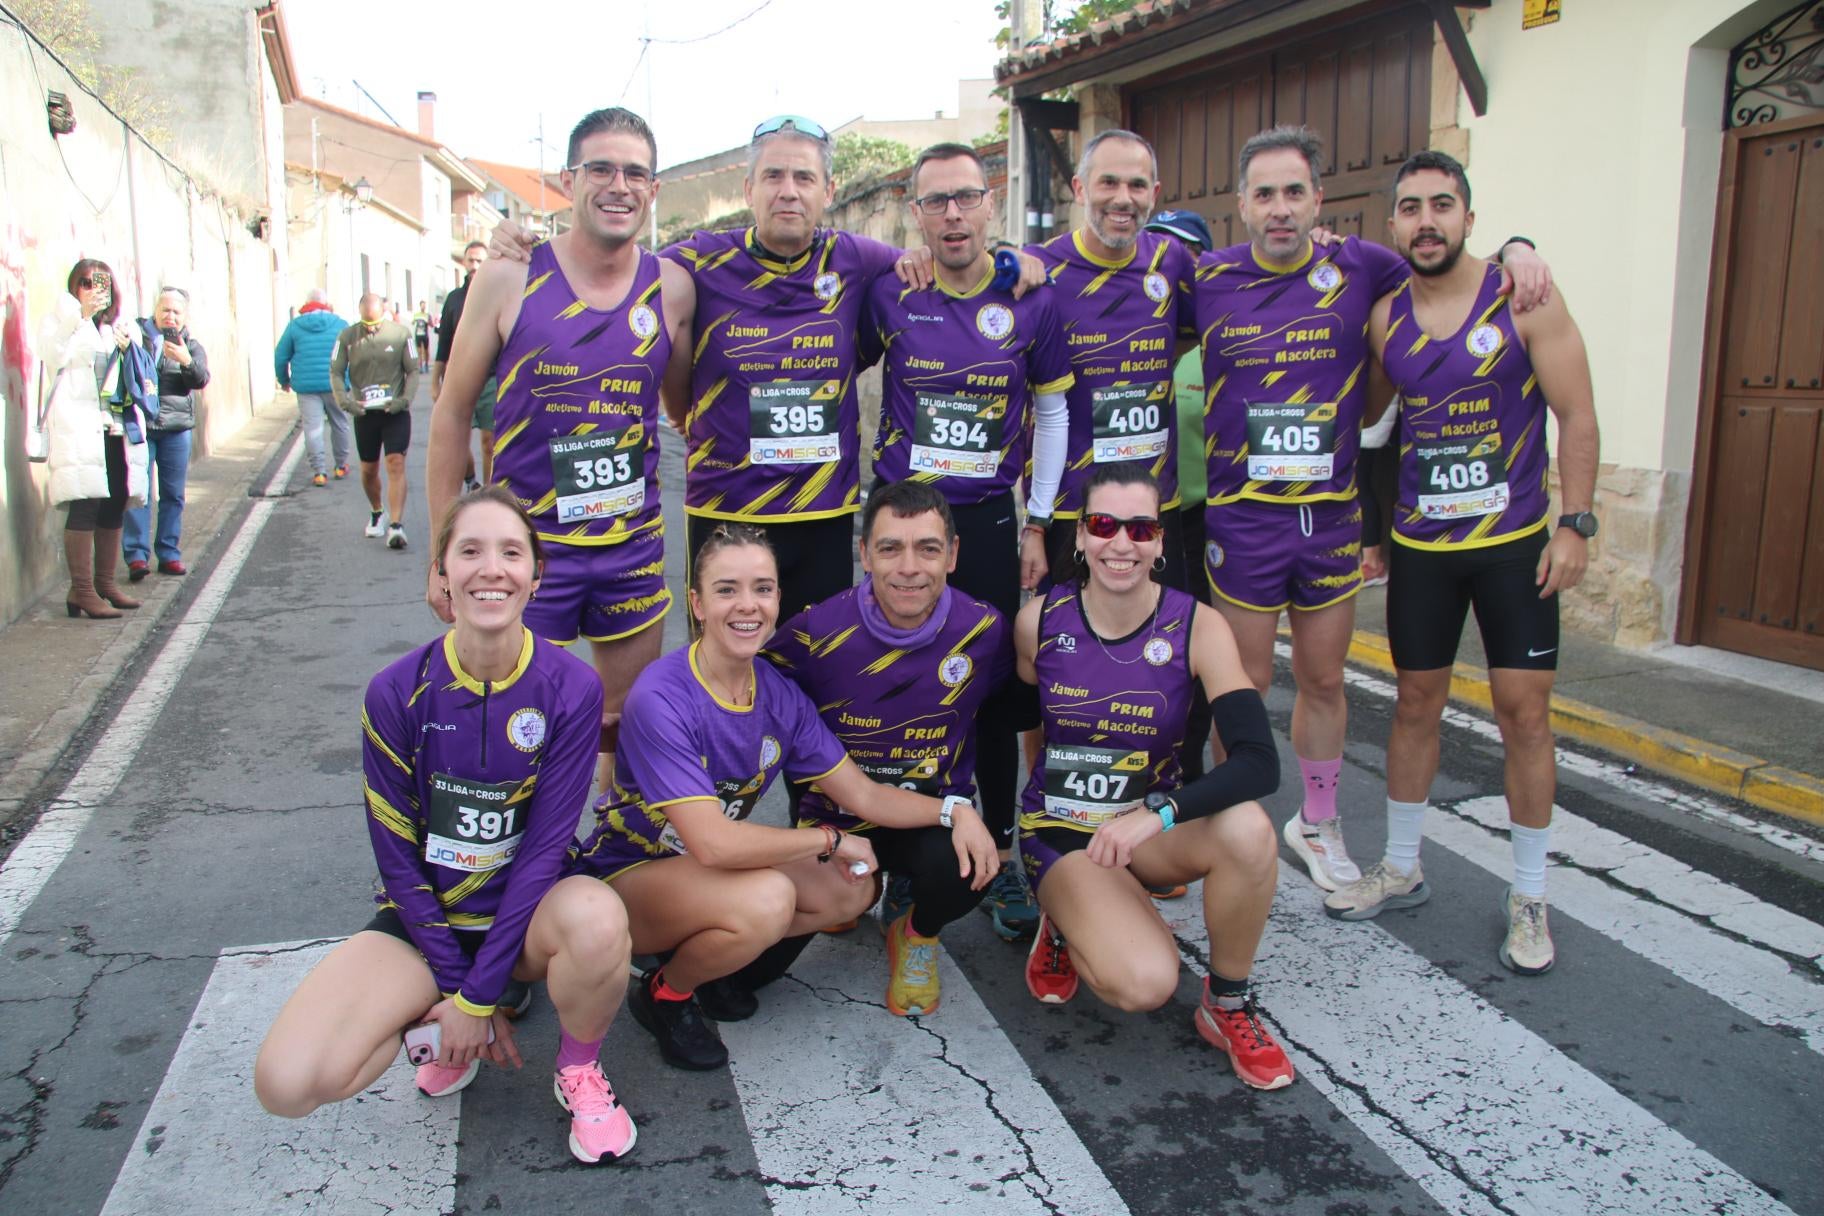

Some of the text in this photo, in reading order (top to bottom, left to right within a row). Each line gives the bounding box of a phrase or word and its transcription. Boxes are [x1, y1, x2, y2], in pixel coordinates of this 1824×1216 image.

[726, 323, 768, 338] Jamón
[1221, 324, 1261, 338] Jamón
[1285, 328, 1330, 343] PRIM
[792, 335, 834, 349] PRIM
[1067, 333, 1107, 345] Jamón
[1130, 338, 1165, 352] PRIM
[739, 354, 839, 371] Atletismo Macotera
[1275, 347, 1336, 363] Macotera
[534, 361, 578, 376] Jamón
[905, 356, 944, 370] Jamón
[1120, 358, 1168, 373] Macotera
[600, 378, 642, 395] PRIM
[967, 374, 1008, 387] PRIM
[365, 389, 386, 401] 270
[762, 387, 781, 397] LIGA
[785, 387, 810, 396] CROSS
[1103, 391, 1120, 401] LIGA
[1125, 388, 1147, 399] CROSS
[545, 400, 643, 416] Atletismo Macotera
[919, 397, 929, 408] 33
[929, 398, 946, 409] LIGA
[952, 403, 978, 412] CROSS
[1449, 398, 1490, 417] PRIM
[770, 405, 824, 434] 395
[1109, 404, 1159, 433] 400
[1257, 409, 1275, 417] LIGA
[1281, 408, 1305, 417] CROSS
[930, 417, 988, 449] 394
[1442, 419, 1498, 437] Macotera
[553, 444, 564, 454] 33
[564, 441, 584, 452] LIGA
[590, 436, 616, 448] CROSS
[1261, 425, 1320, 452] 405
[1443, 445, 1468, 455] CROSS
[574, 453, 631, 490] 393
[914, 457, 995, 473] JOMISAGA
[1251, 465, 1330, 476] JOMISAGA
[1430, 461, 1489, 491] 408
[562, 492, 644, 519] JOMISAGA
[1050, 682, 1089, 697] Jamón
[1110, 702, 1154, 718] PRIM
[839, 712, 881, 728] Jamón
[1057, 719, 1157, 735] Atletismo Macotera
[904, 725, 947, 740] PRIM
[890, 745, 949, 759] Macotera
[1050, 750, 1060, 761] 33
[1060, 752, 1079, 762] LIGA
[1085, 754, 1112, 764] CROSS
[877, 767, 903, 775] CROSS
[435, 780, 447, 790] 33
[447, 783, 468, 795] LIGA
[475, 790, 507, 801] CROSS
[1064, 772, 1129, 800] 407
[456, 805, 516, 840] 391
